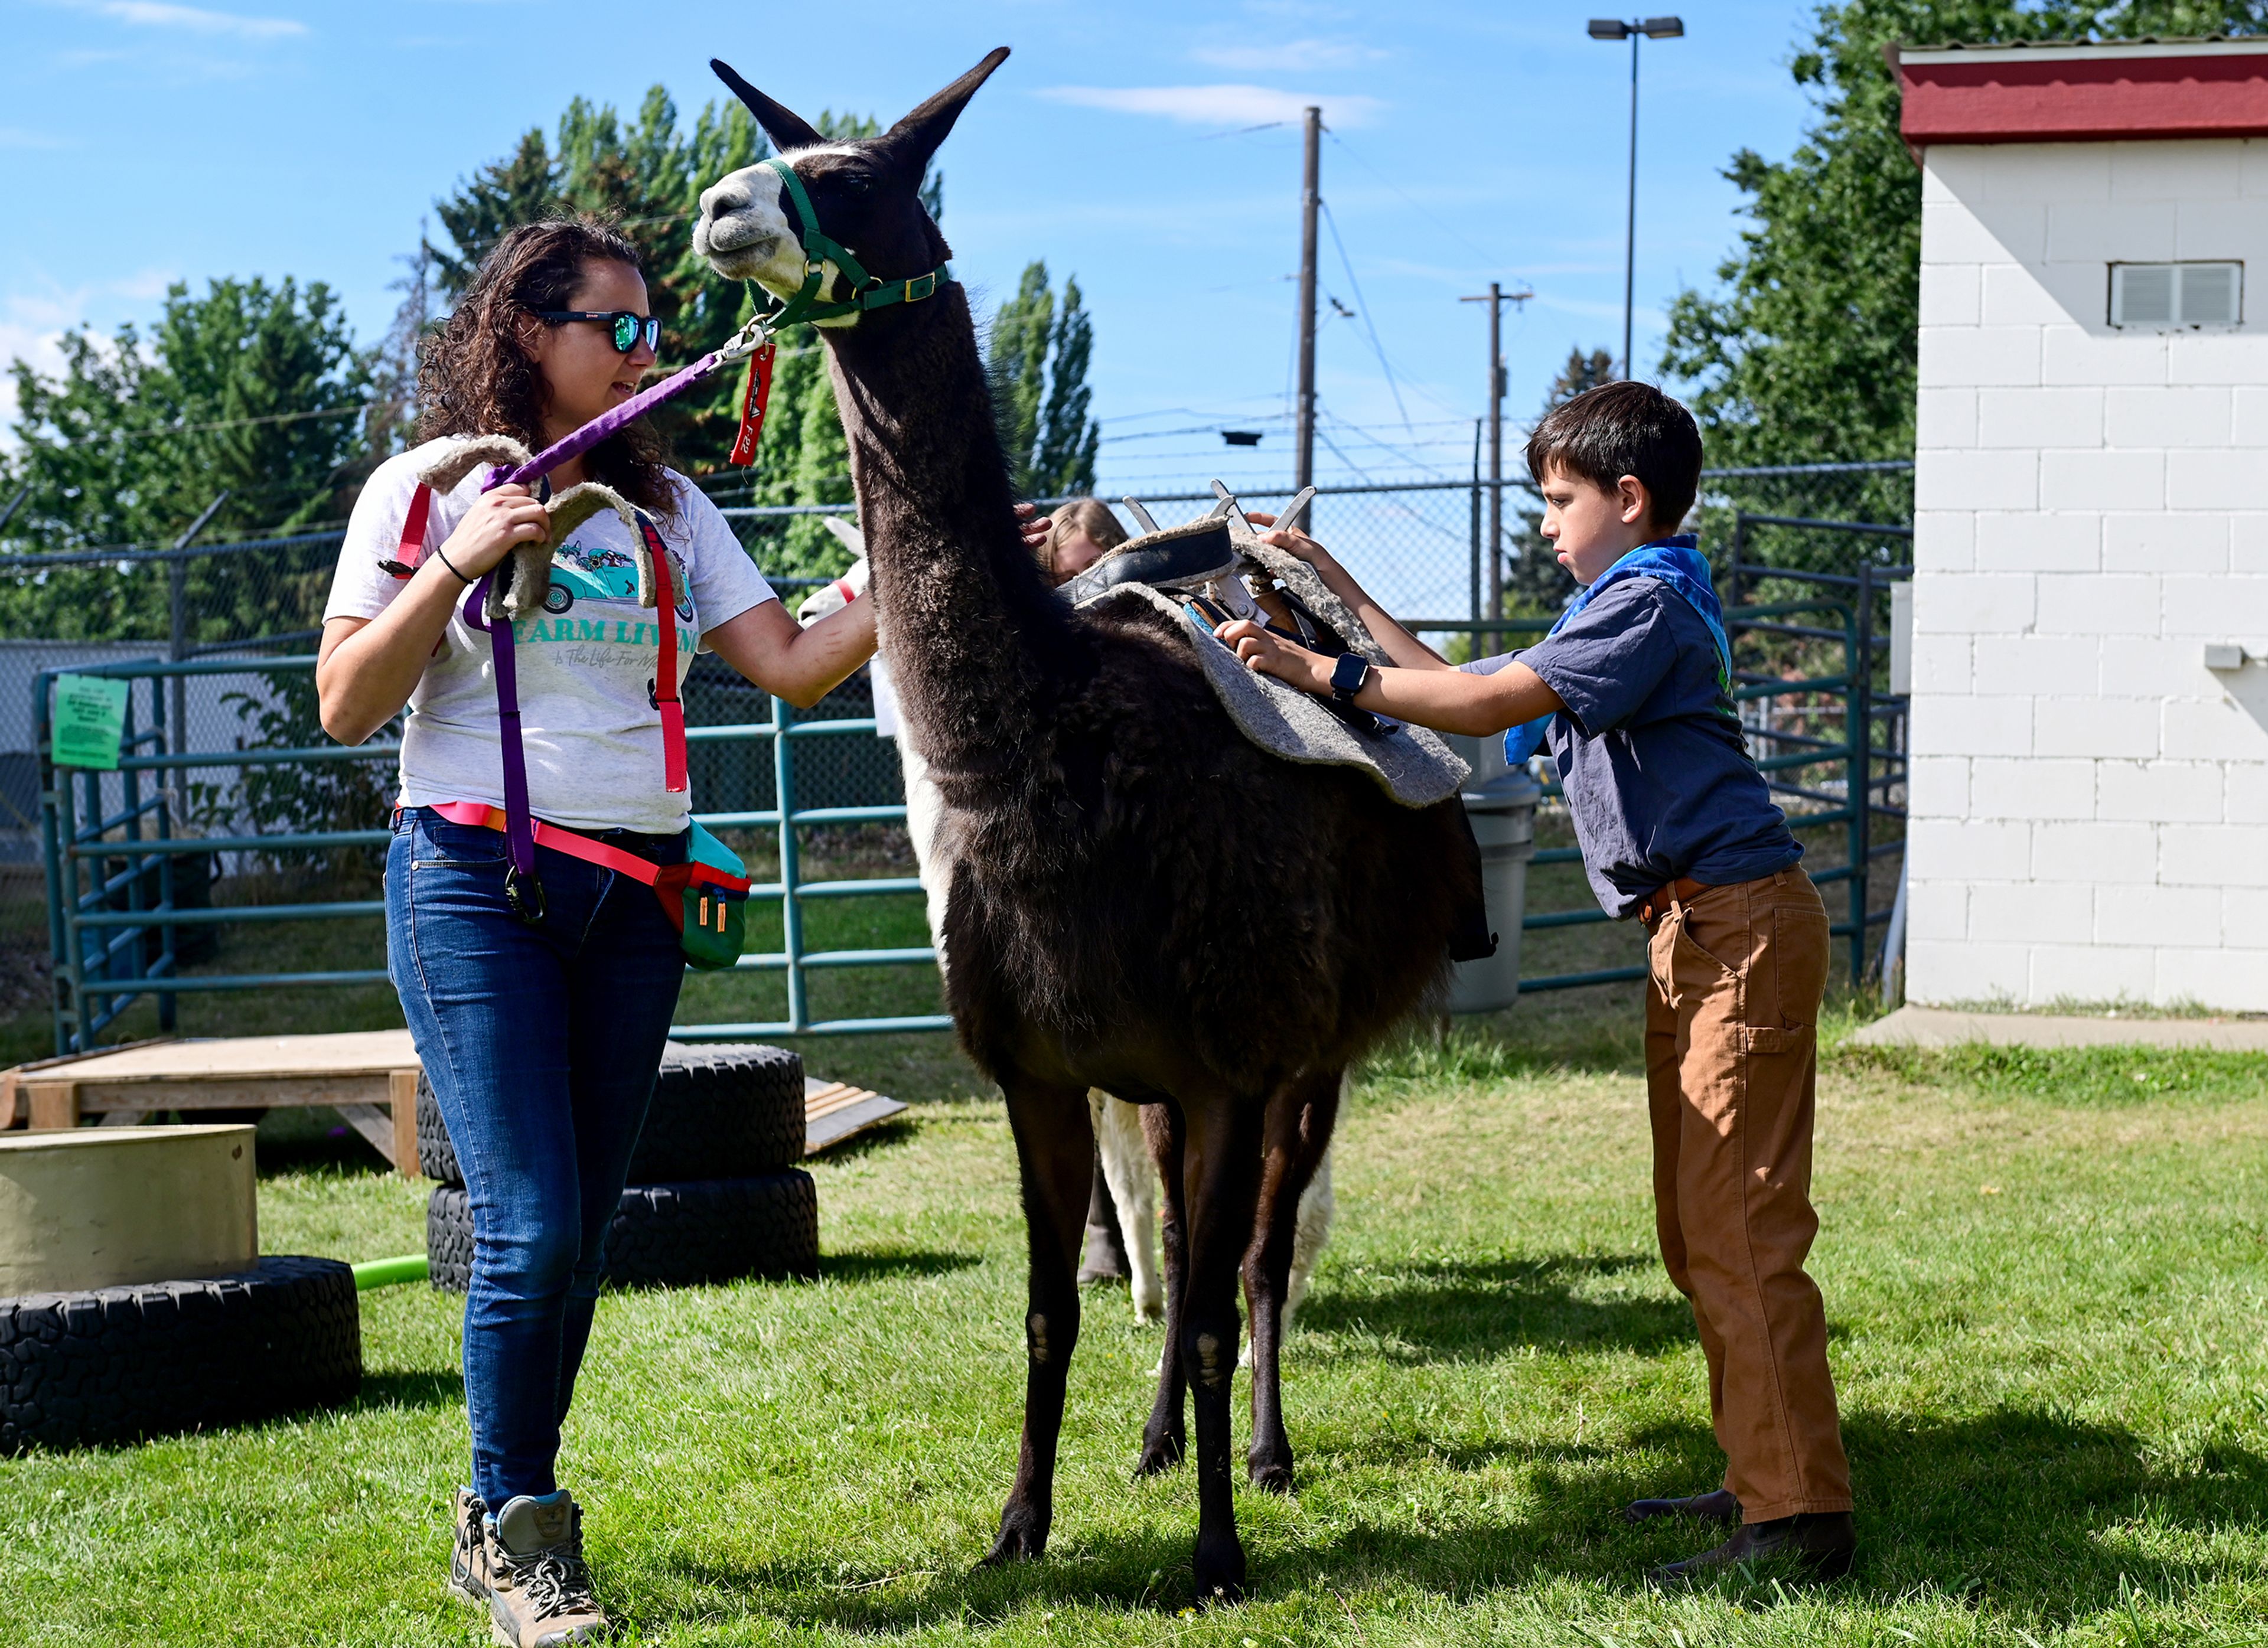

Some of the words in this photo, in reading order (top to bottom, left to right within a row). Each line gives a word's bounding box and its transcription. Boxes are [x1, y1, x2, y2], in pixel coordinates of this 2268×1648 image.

[740, 425, 754, 454] F-22
[512, 618, 606, 645] FARM
[566, 644, 586, 667] The
[588, 647, 612, 668] Life
[617, 650, 637, 666] For
